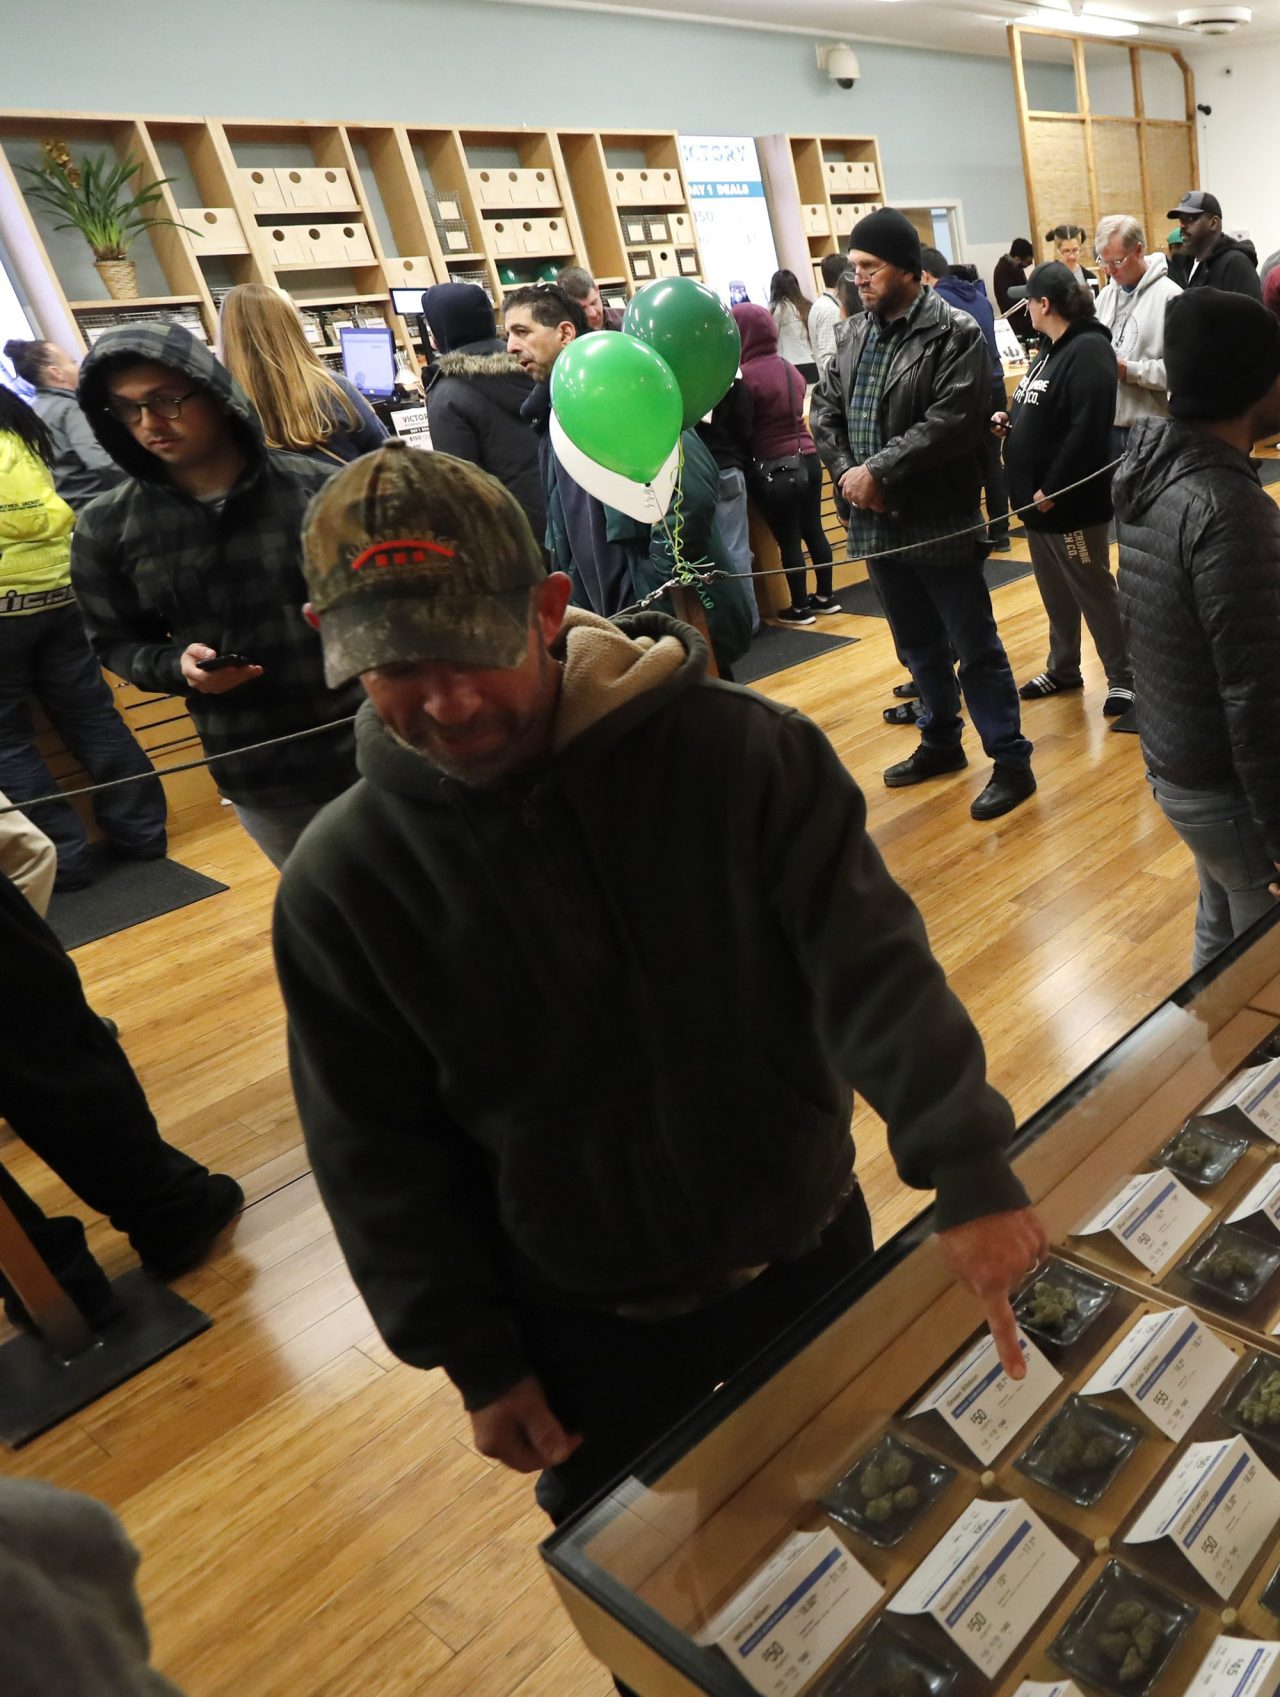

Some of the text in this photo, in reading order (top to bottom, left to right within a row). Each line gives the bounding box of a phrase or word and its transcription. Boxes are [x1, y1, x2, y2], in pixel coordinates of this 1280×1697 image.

[683, 145, 745, 161] ICTORY
[716, 184, 750, 196] DEALS
[1073, 530, 1091, 565] CROMBIE
[1136, 1231, 1152, 1247] $50
[1152, 1389, 1171, 1408] $55
[968, 1407, 989, 1427] $50
[1175, 1512, 1194, 1535] Lemon
[1199, 1534, 1220, 1557] $50
[964, 1610, 989, 1636] $50
[759, 1639, 786, 1666] $50
[1224, 1653, 1246, 1678] $45
